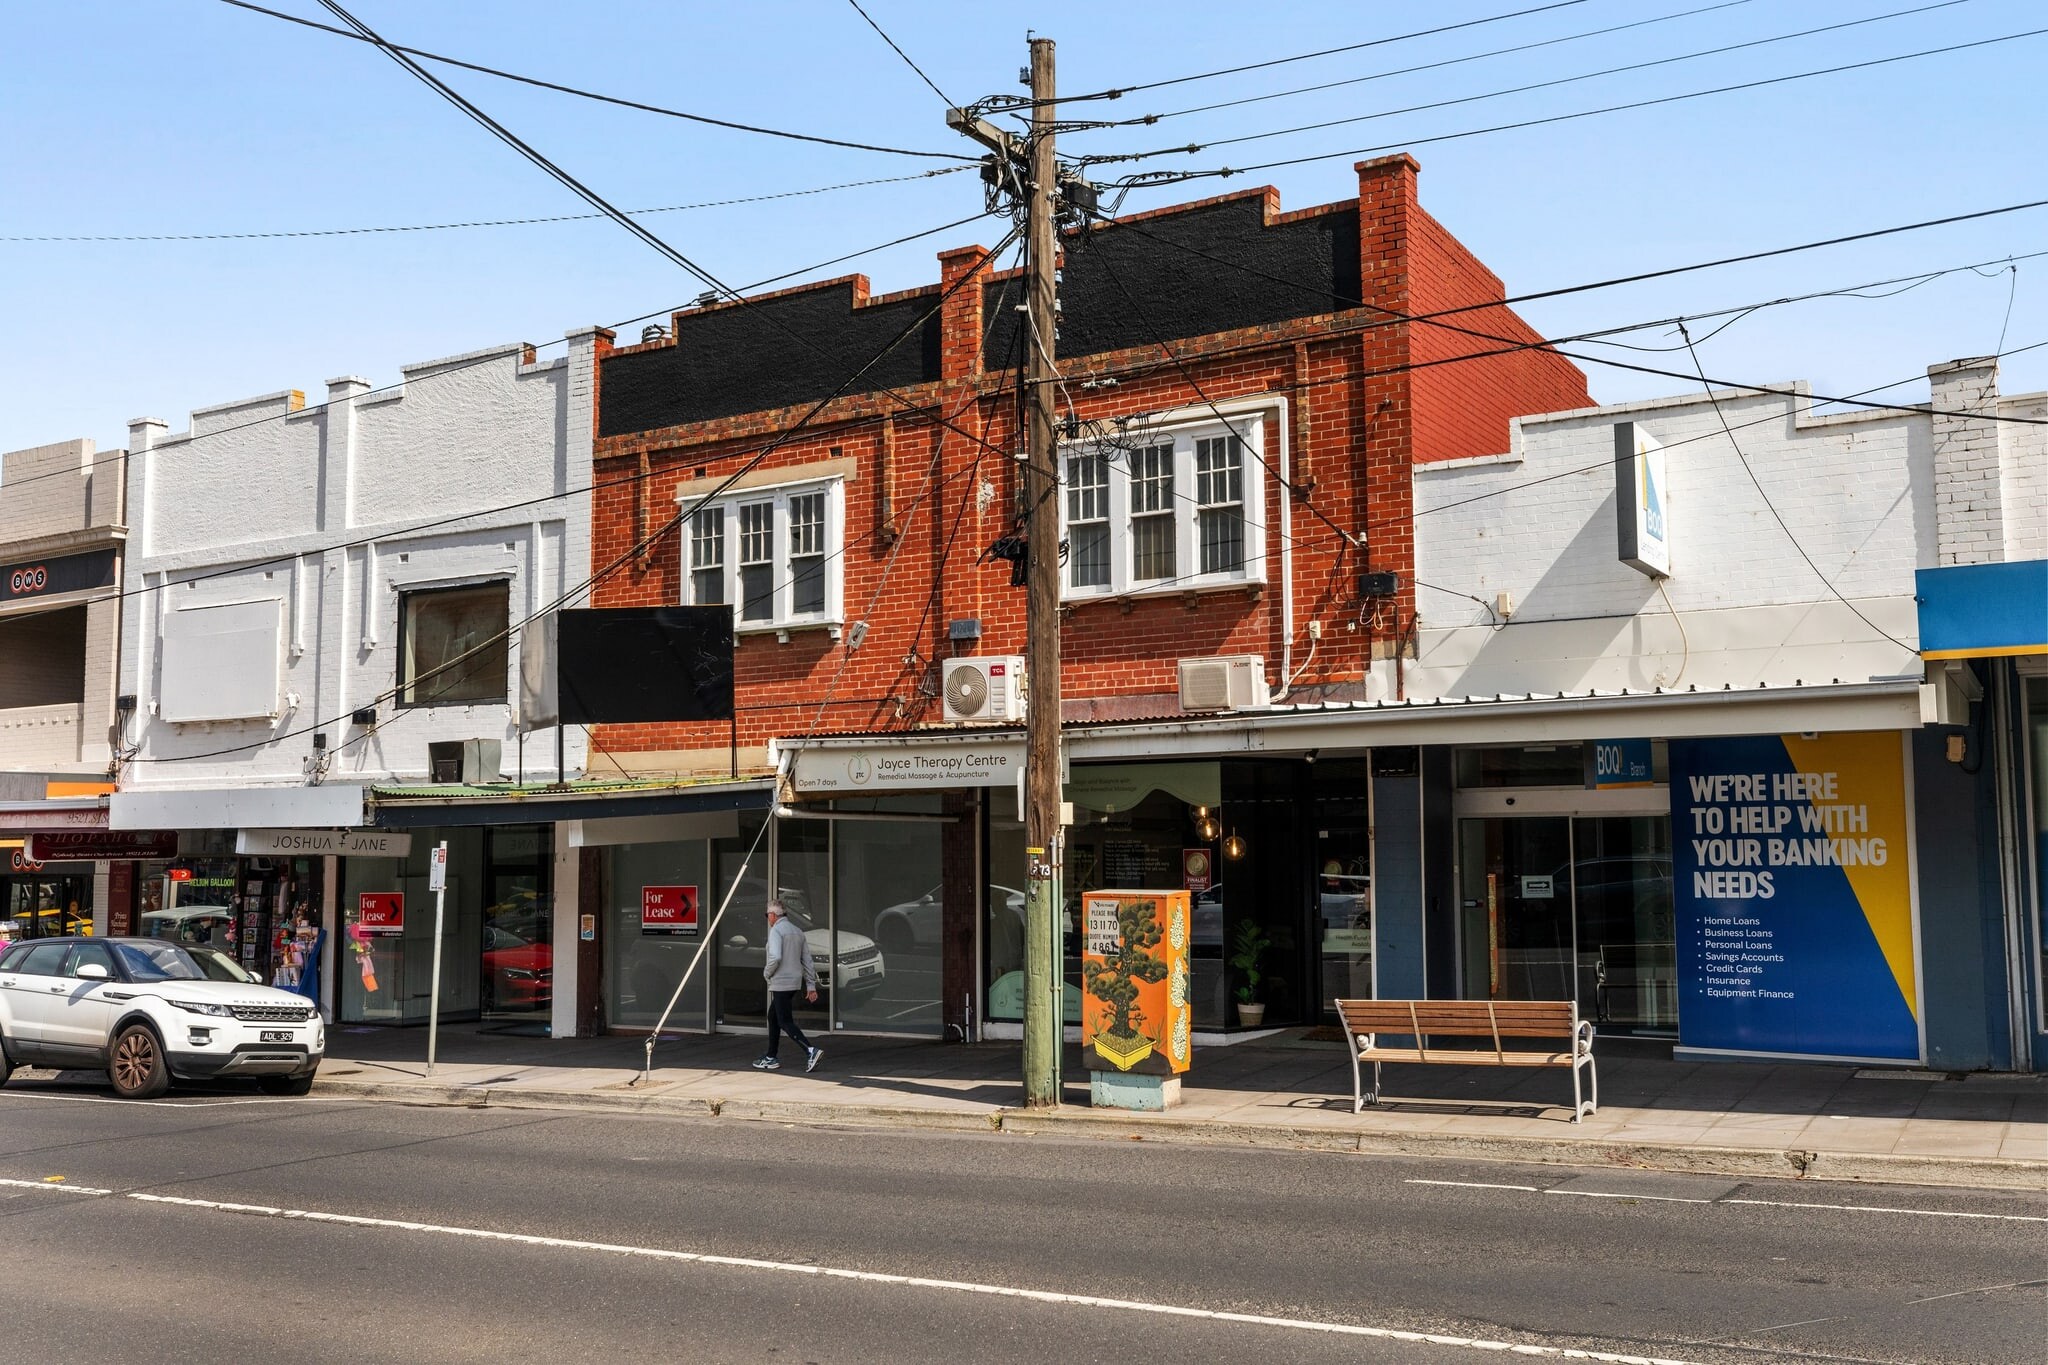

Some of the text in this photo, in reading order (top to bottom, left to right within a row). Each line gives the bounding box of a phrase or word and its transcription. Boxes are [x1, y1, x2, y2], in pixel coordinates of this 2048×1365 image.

[877, 754, 1007, 771] Jayce Therapy Centre
[1596, 745, 1646, 776] BOQ Branch
[908, 772, 938, 780] Massage
[946, 770, 990, 779] Acupuncture
[821, 778, 838, 787] days
[1689, 772, 1839, 802] WE'RE HERE
[1691, 804, 1868, 834] TO HELP WITH
[42, 832, 173, 844] SHOPAHOIC
[273, 835, 332, 849] JOSHUA
[351, 838, 388, 850] JANE
[1692, 838, 1887, 867] YOUR BANKING
[210, 878, 235, 887] BALLOON
[1693, 871, 1775, 899] NEEDS
[362, 897, 377, 909] For
[645, 891, 664, 904] For
[362, 910, 386, 921] Lease
[645, 905, 675, 918] Lease
[1090, 920, 1118, 930] 13 11 70
[1704, 916, 1761, 925] Home Loans
[1704, 928, 1774, 938] Business Loans
[1705, 939, 1773, 950] Personal Loans
[1705, 952, 1785, 962] Savings Accounts
[1706, 963, 1763, 974] Credit Cards
[1706, 975, 1751, 985] Insurance
[1707, 987, 1795, 999] Equipment Finance
